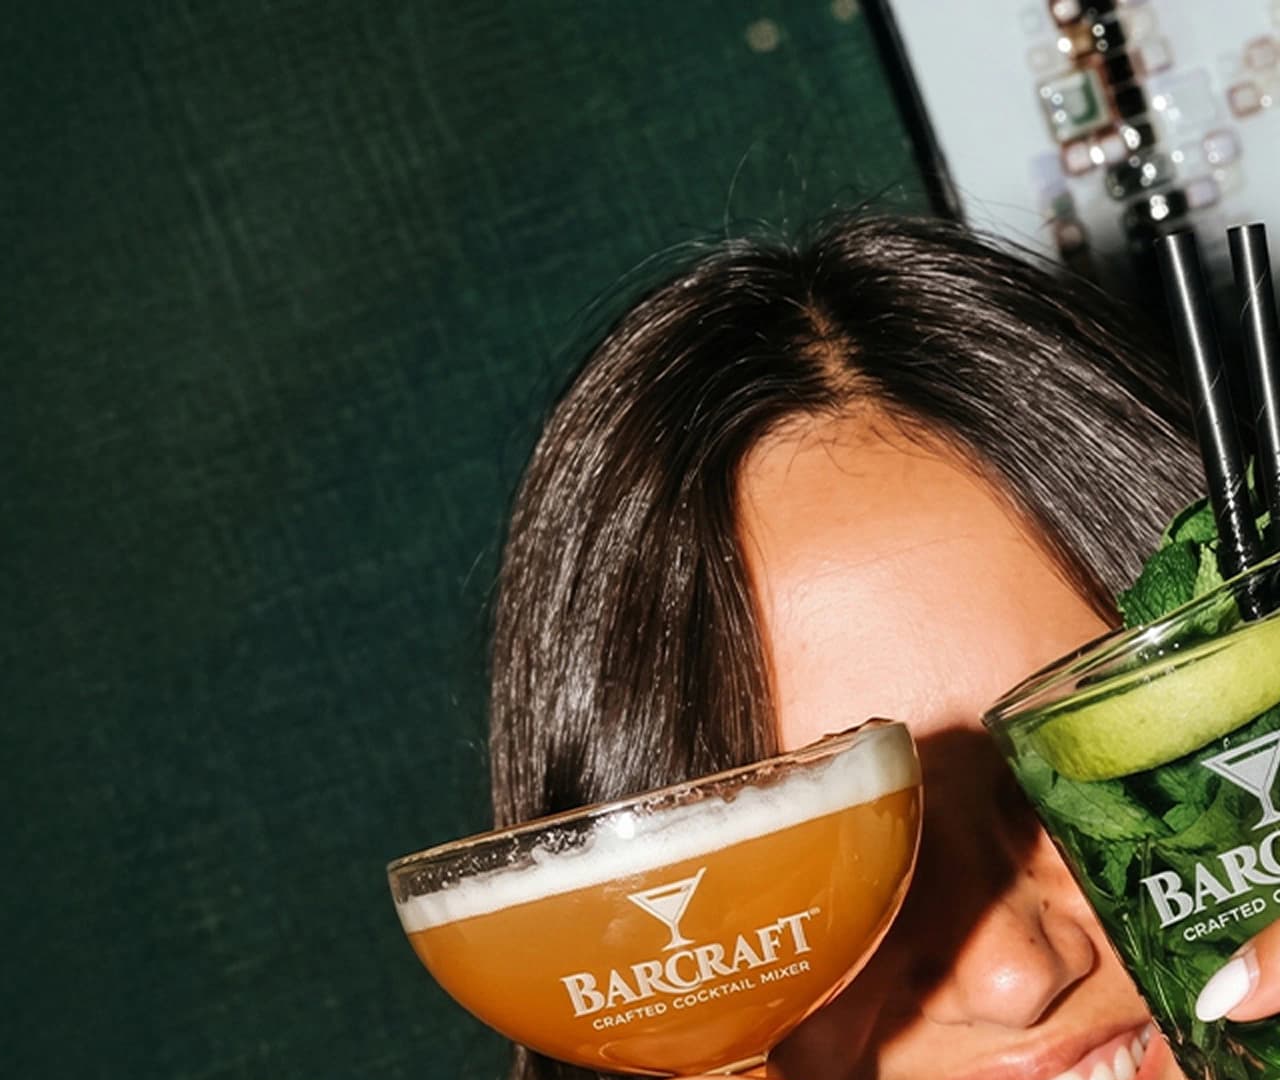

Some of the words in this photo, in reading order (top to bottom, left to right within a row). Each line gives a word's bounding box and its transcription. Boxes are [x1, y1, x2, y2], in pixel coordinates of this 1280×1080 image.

[1183, 897, 1267, 942] CRAFTED
[592, 1003, 667, 1031] CRAFTED
[672, 979, 756, 1010] COCKTAIL
[760, 960, 812, 985] MIXER
